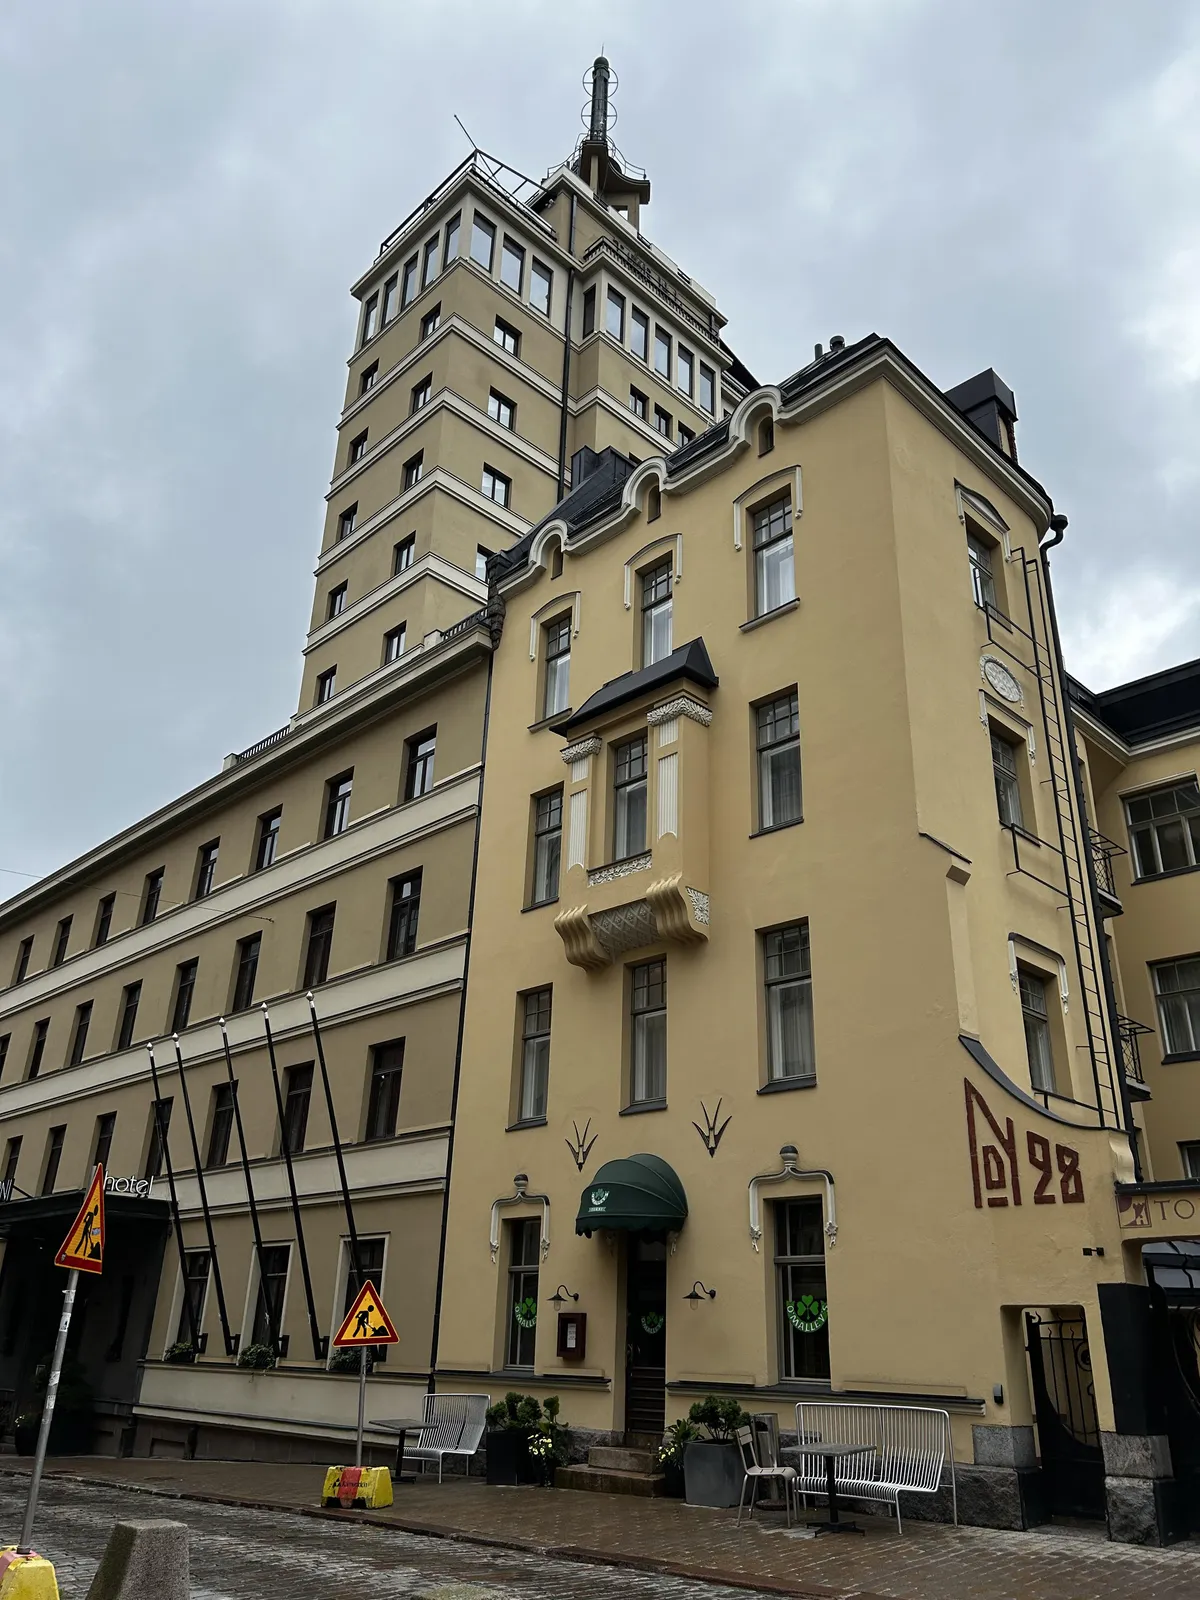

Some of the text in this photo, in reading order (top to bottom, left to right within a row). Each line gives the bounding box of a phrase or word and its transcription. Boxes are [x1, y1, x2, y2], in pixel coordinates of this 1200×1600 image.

[1026, 1130, 1085, 1205] 28
[103, 1171, 154, 1194] hotel
[1153, 1198, 1200, 1220] TO
[514, 1305, 537, 1328] O'MALLE
[786, 1304, 828, 1332] O'MALLEY'S
